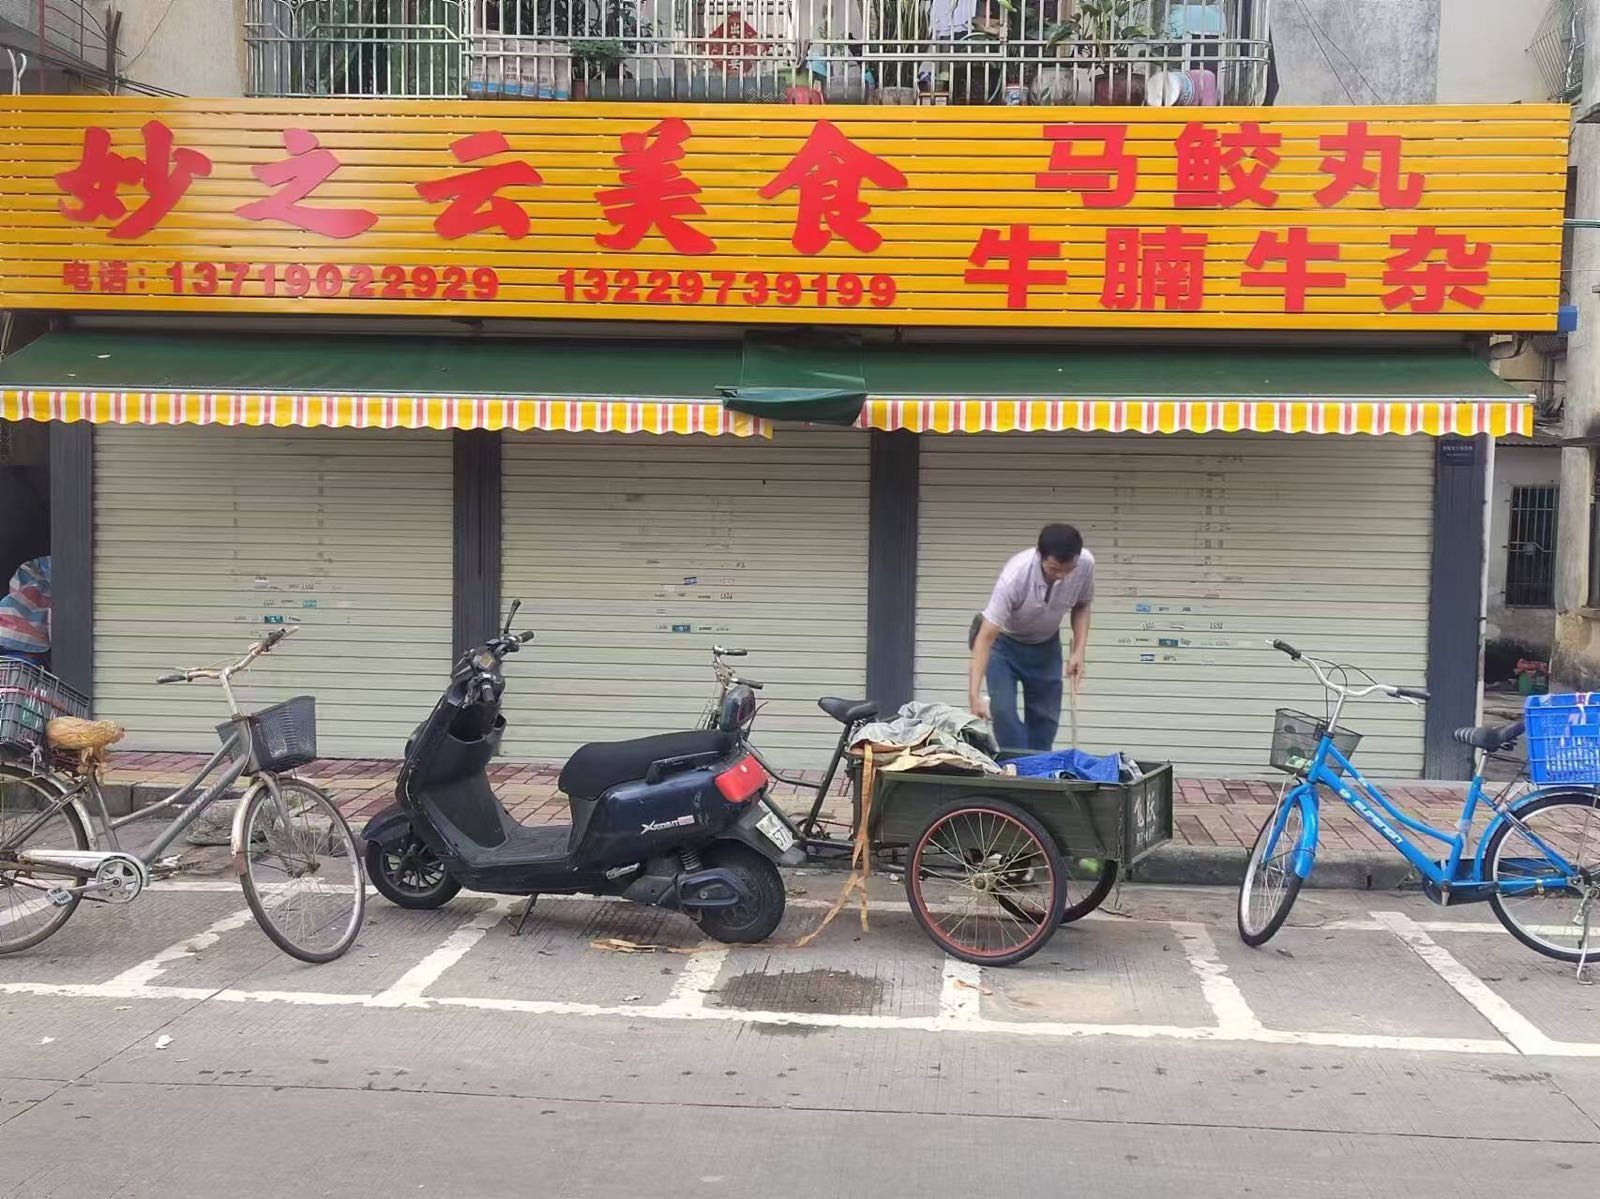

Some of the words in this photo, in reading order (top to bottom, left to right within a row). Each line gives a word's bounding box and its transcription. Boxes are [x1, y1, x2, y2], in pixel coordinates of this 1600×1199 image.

[54, 118, 906, 256] 妙之云美食
[1035, 121, 1425, 210] 马鲛丸
[558, 268, 897, 308] 13229739199
[964, 224, 1492, 313] 牛腩牛杂
